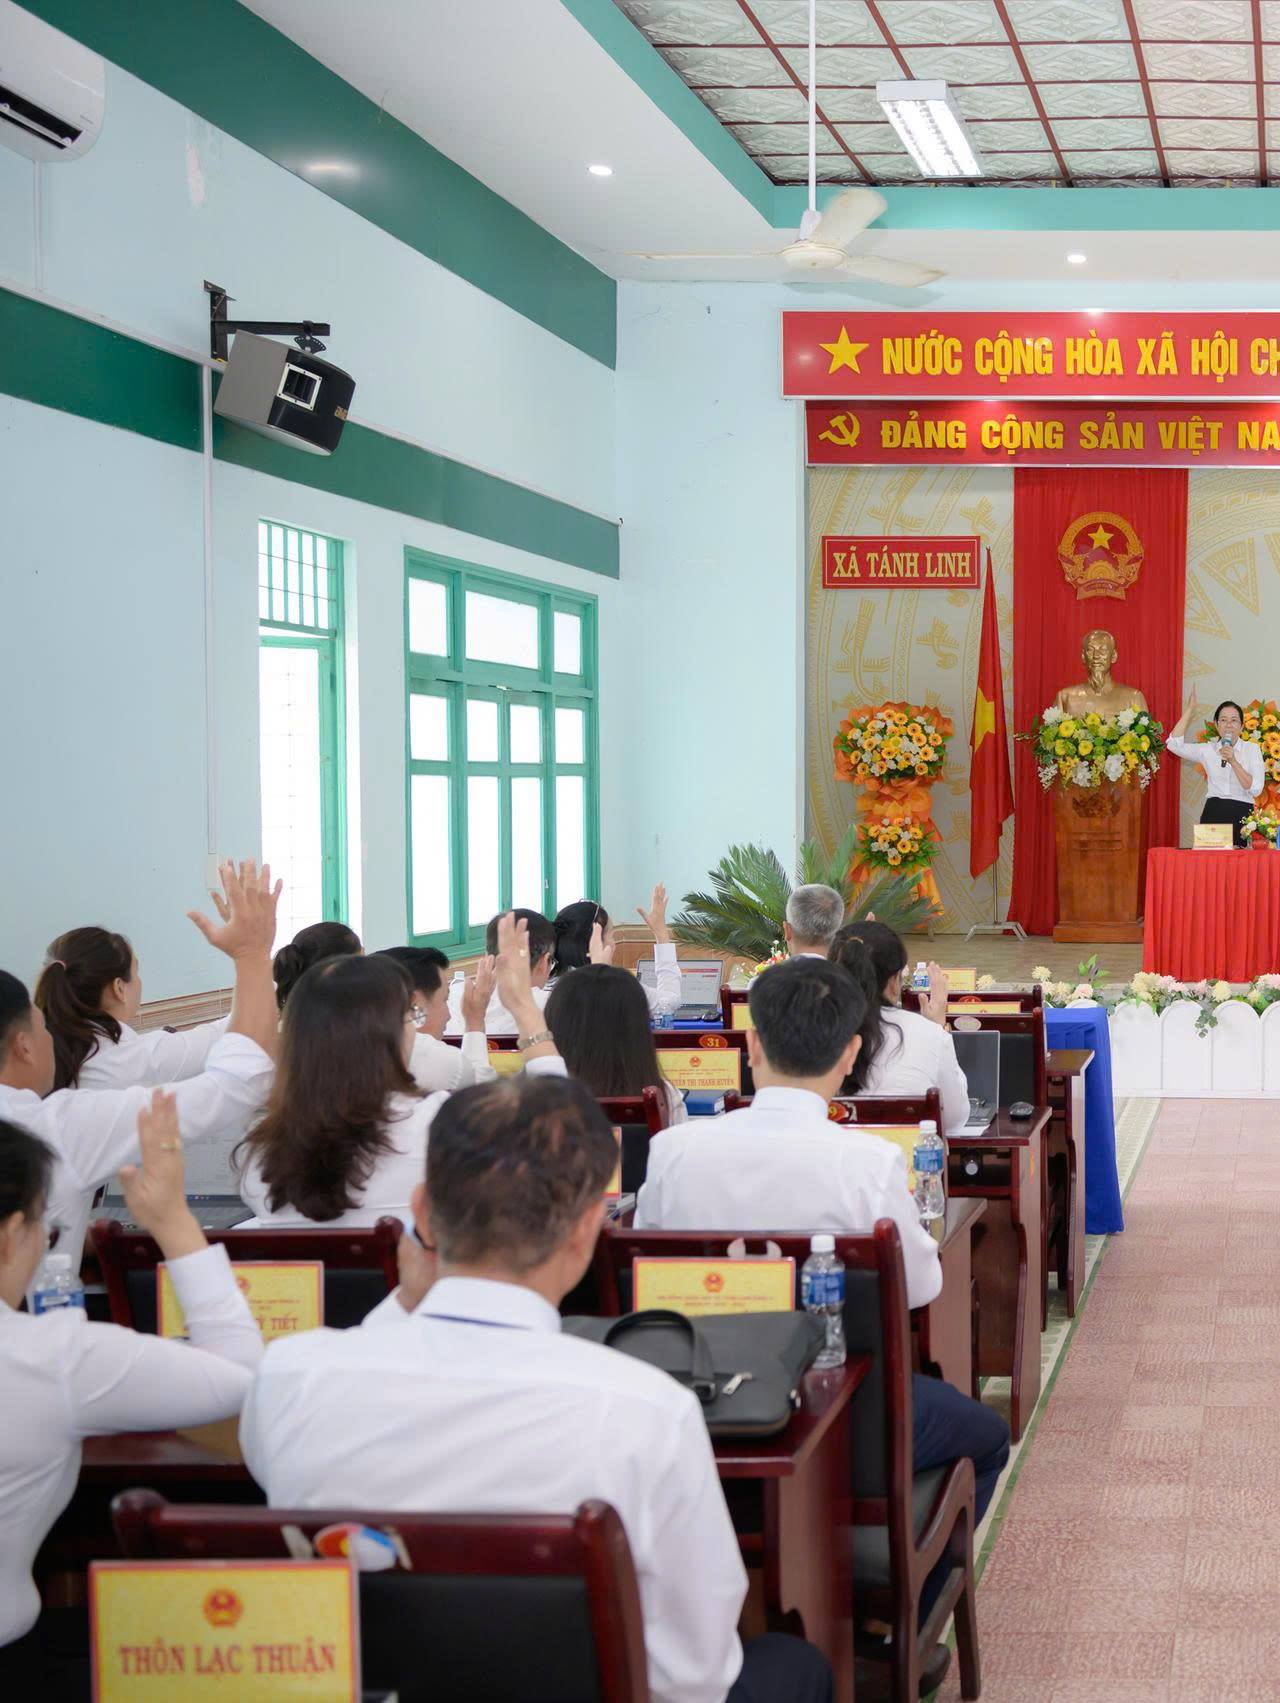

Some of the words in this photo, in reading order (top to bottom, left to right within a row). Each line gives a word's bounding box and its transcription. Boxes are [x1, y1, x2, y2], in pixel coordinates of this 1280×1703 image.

[881, 330, 963, 377] NƯỚC
[974, 329, 1054, 383] CỘNG
[1065, 329, 1125, 377] HÒA
[1136, 331, 1179, 376] XÃ
[1190, 330, 1238, 383] HỘI
[880, 410, 967, 450] ĐẢNG
[980, 413, 1064, 456] CỘNG
[1078, 411, 1145, 450] SẢN
[1157, 415, 1222, 456] VIỆT
[832, 546, 861, 578] XÃ
[866, 546, 919, 578] TÁNH
[924, 552, 972, 579] LINH
[707, 1037, 720, 1048] 31
[119, 1637, 186, 1675] THÔN
[191, 1644, 243, 1681] LẠC
[252, 1637, 336, 1681] THUẬN
